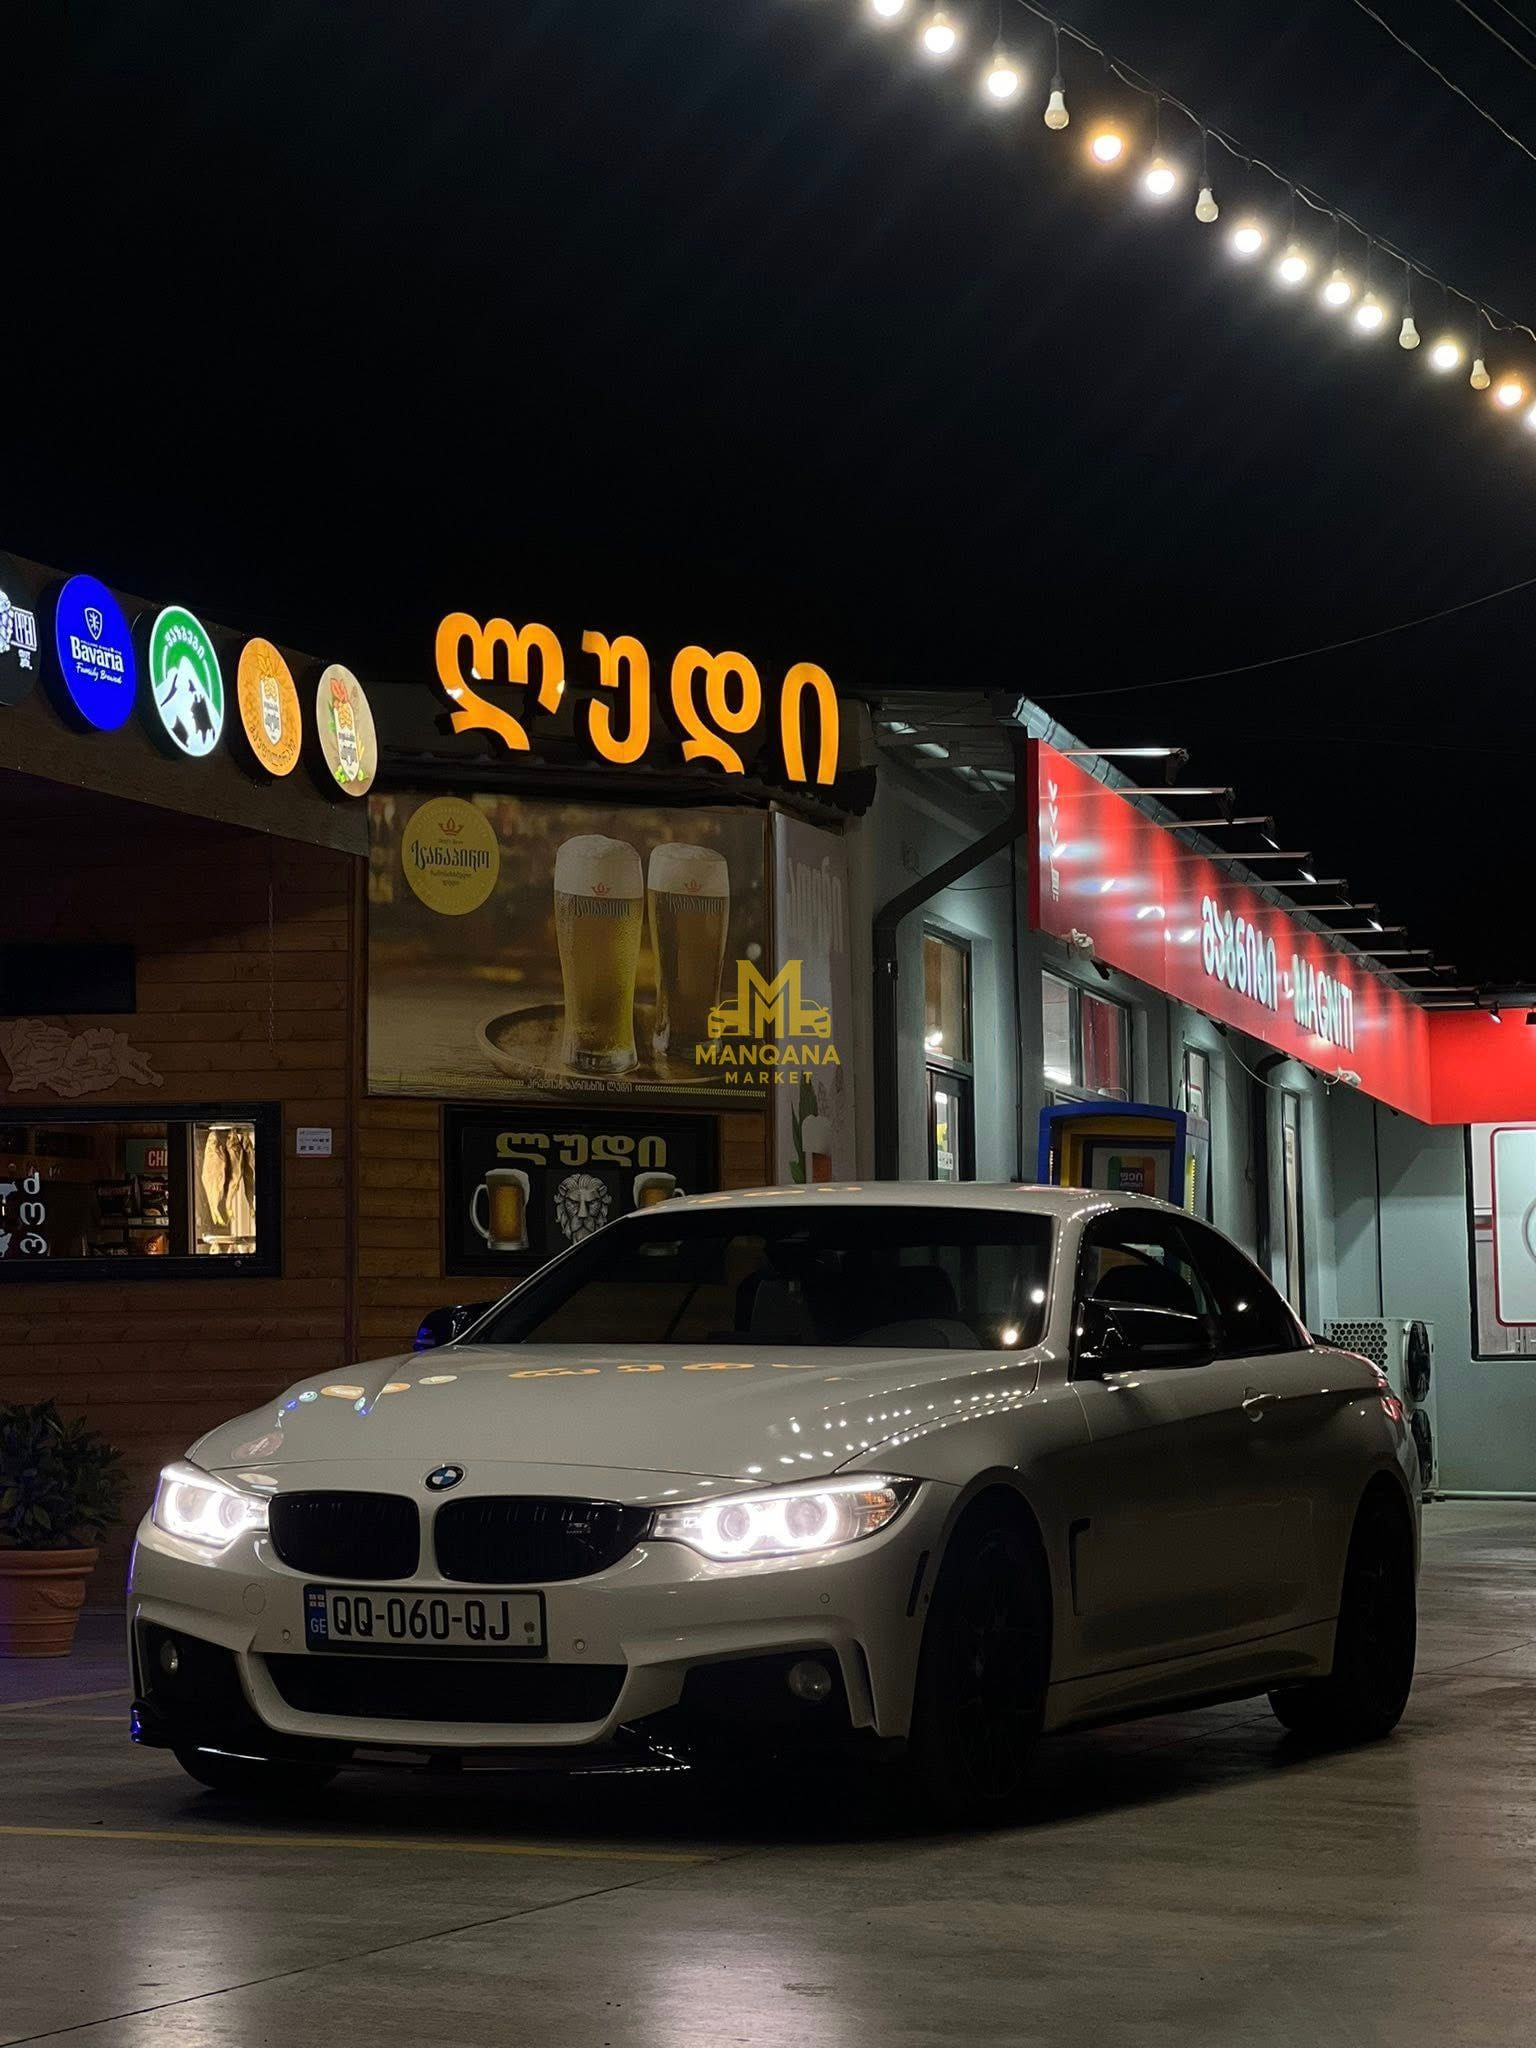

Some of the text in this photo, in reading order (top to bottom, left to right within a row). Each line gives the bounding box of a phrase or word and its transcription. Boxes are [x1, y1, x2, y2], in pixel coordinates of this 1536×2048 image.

[69, 635, 125, 673] Bavaria
[435, 611, 840, 787] ლუდი
[1202, 895, 1279, 1013] მაგნიტი
[1292, 953, 1355, 1054] MAGNITI
[495, 1131, 668, 1168] ლუდი
[310, 1617, 327, 1634] GE
[332, 1596, 510, 1642] QQ-060-QJ
